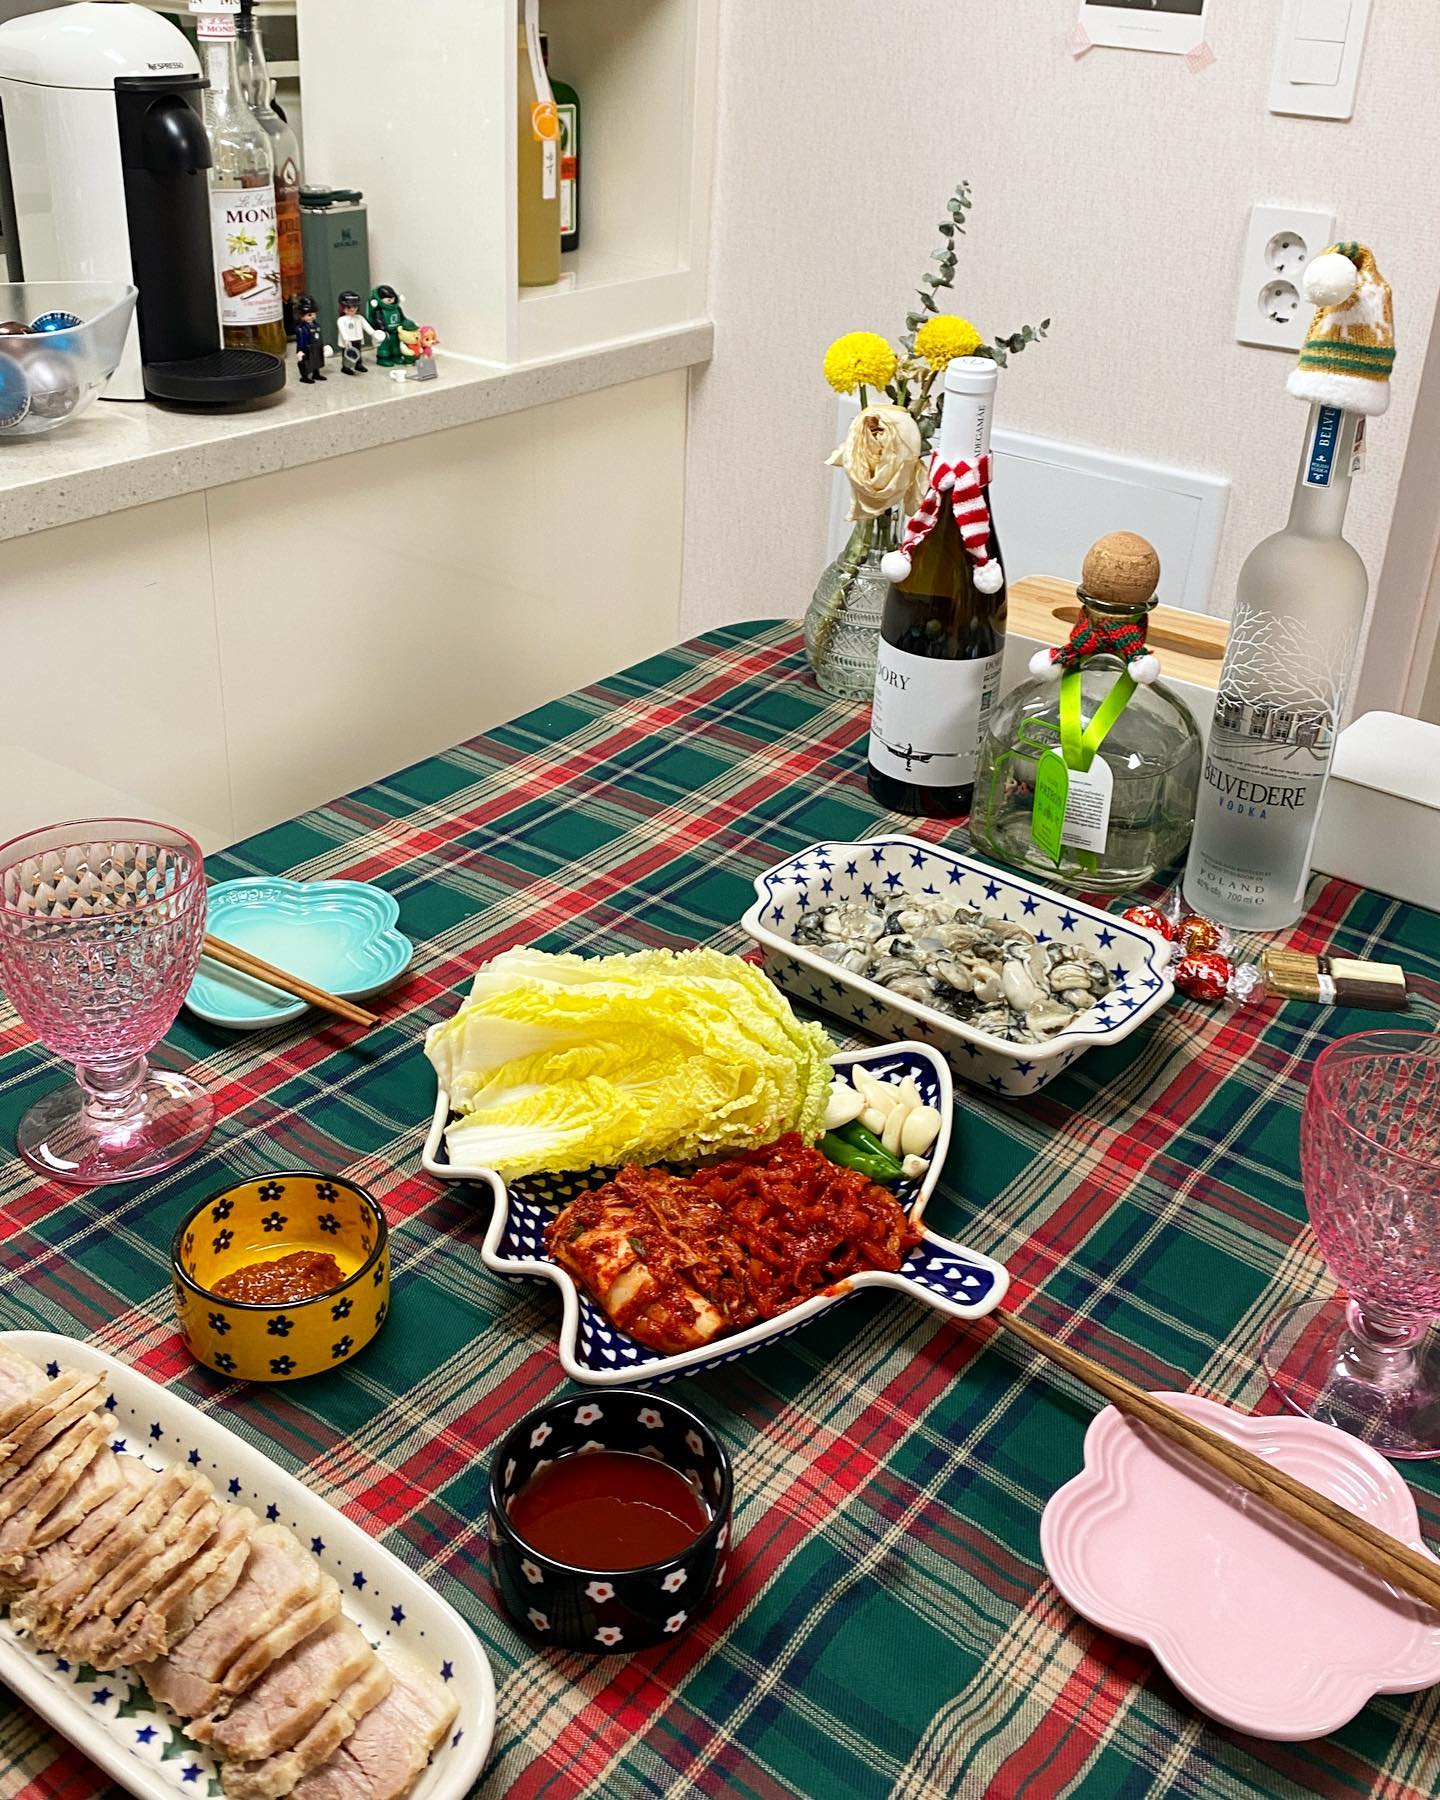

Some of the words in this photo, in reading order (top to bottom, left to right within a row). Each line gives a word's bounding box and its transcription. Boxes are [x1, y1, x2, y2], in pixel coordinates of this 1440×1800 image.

[1203, 757, 1307, 810] BELVEDERE
[1218, 796, 1268, 820] VODKA
[1199, 867, 1265, 894] POLAND
